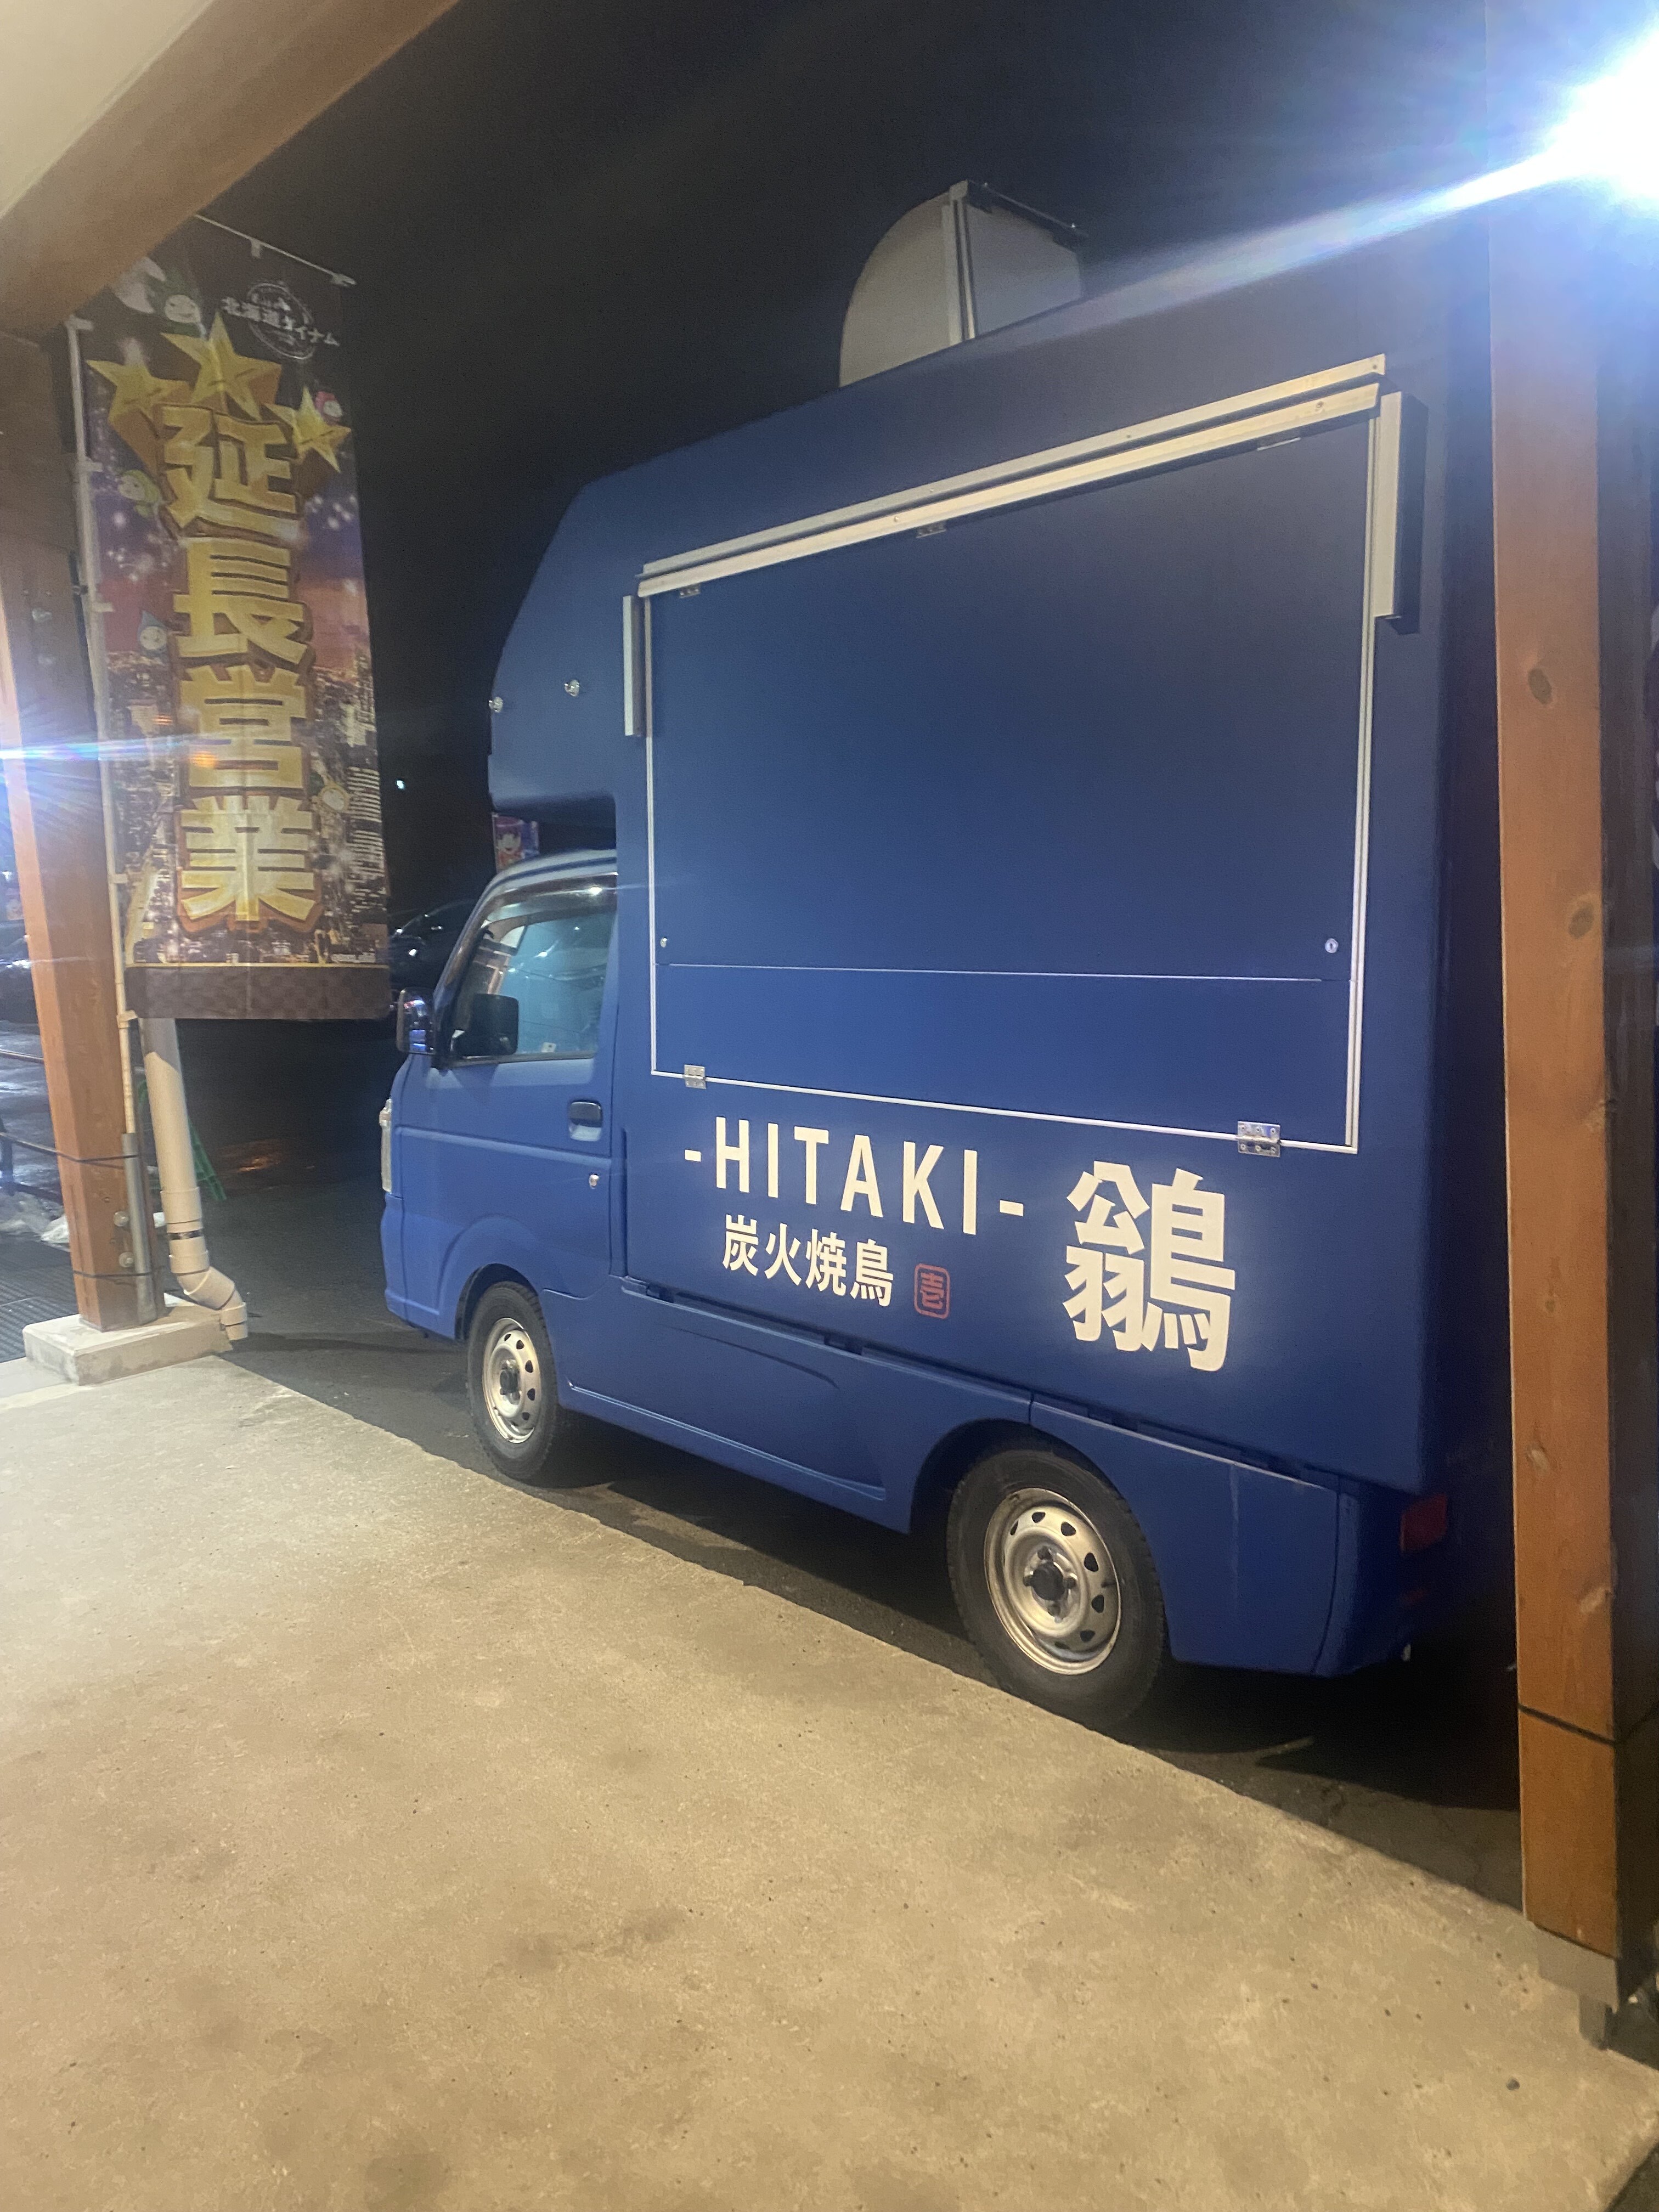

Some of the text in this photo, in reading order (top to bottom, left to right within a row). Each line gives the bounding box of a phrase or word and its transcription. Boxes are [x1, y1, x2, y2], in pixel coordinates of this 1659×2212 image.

[164, 404, 317, 923] 延長営業
[721, 1214, 894, 1307] 炭火焼鳥
